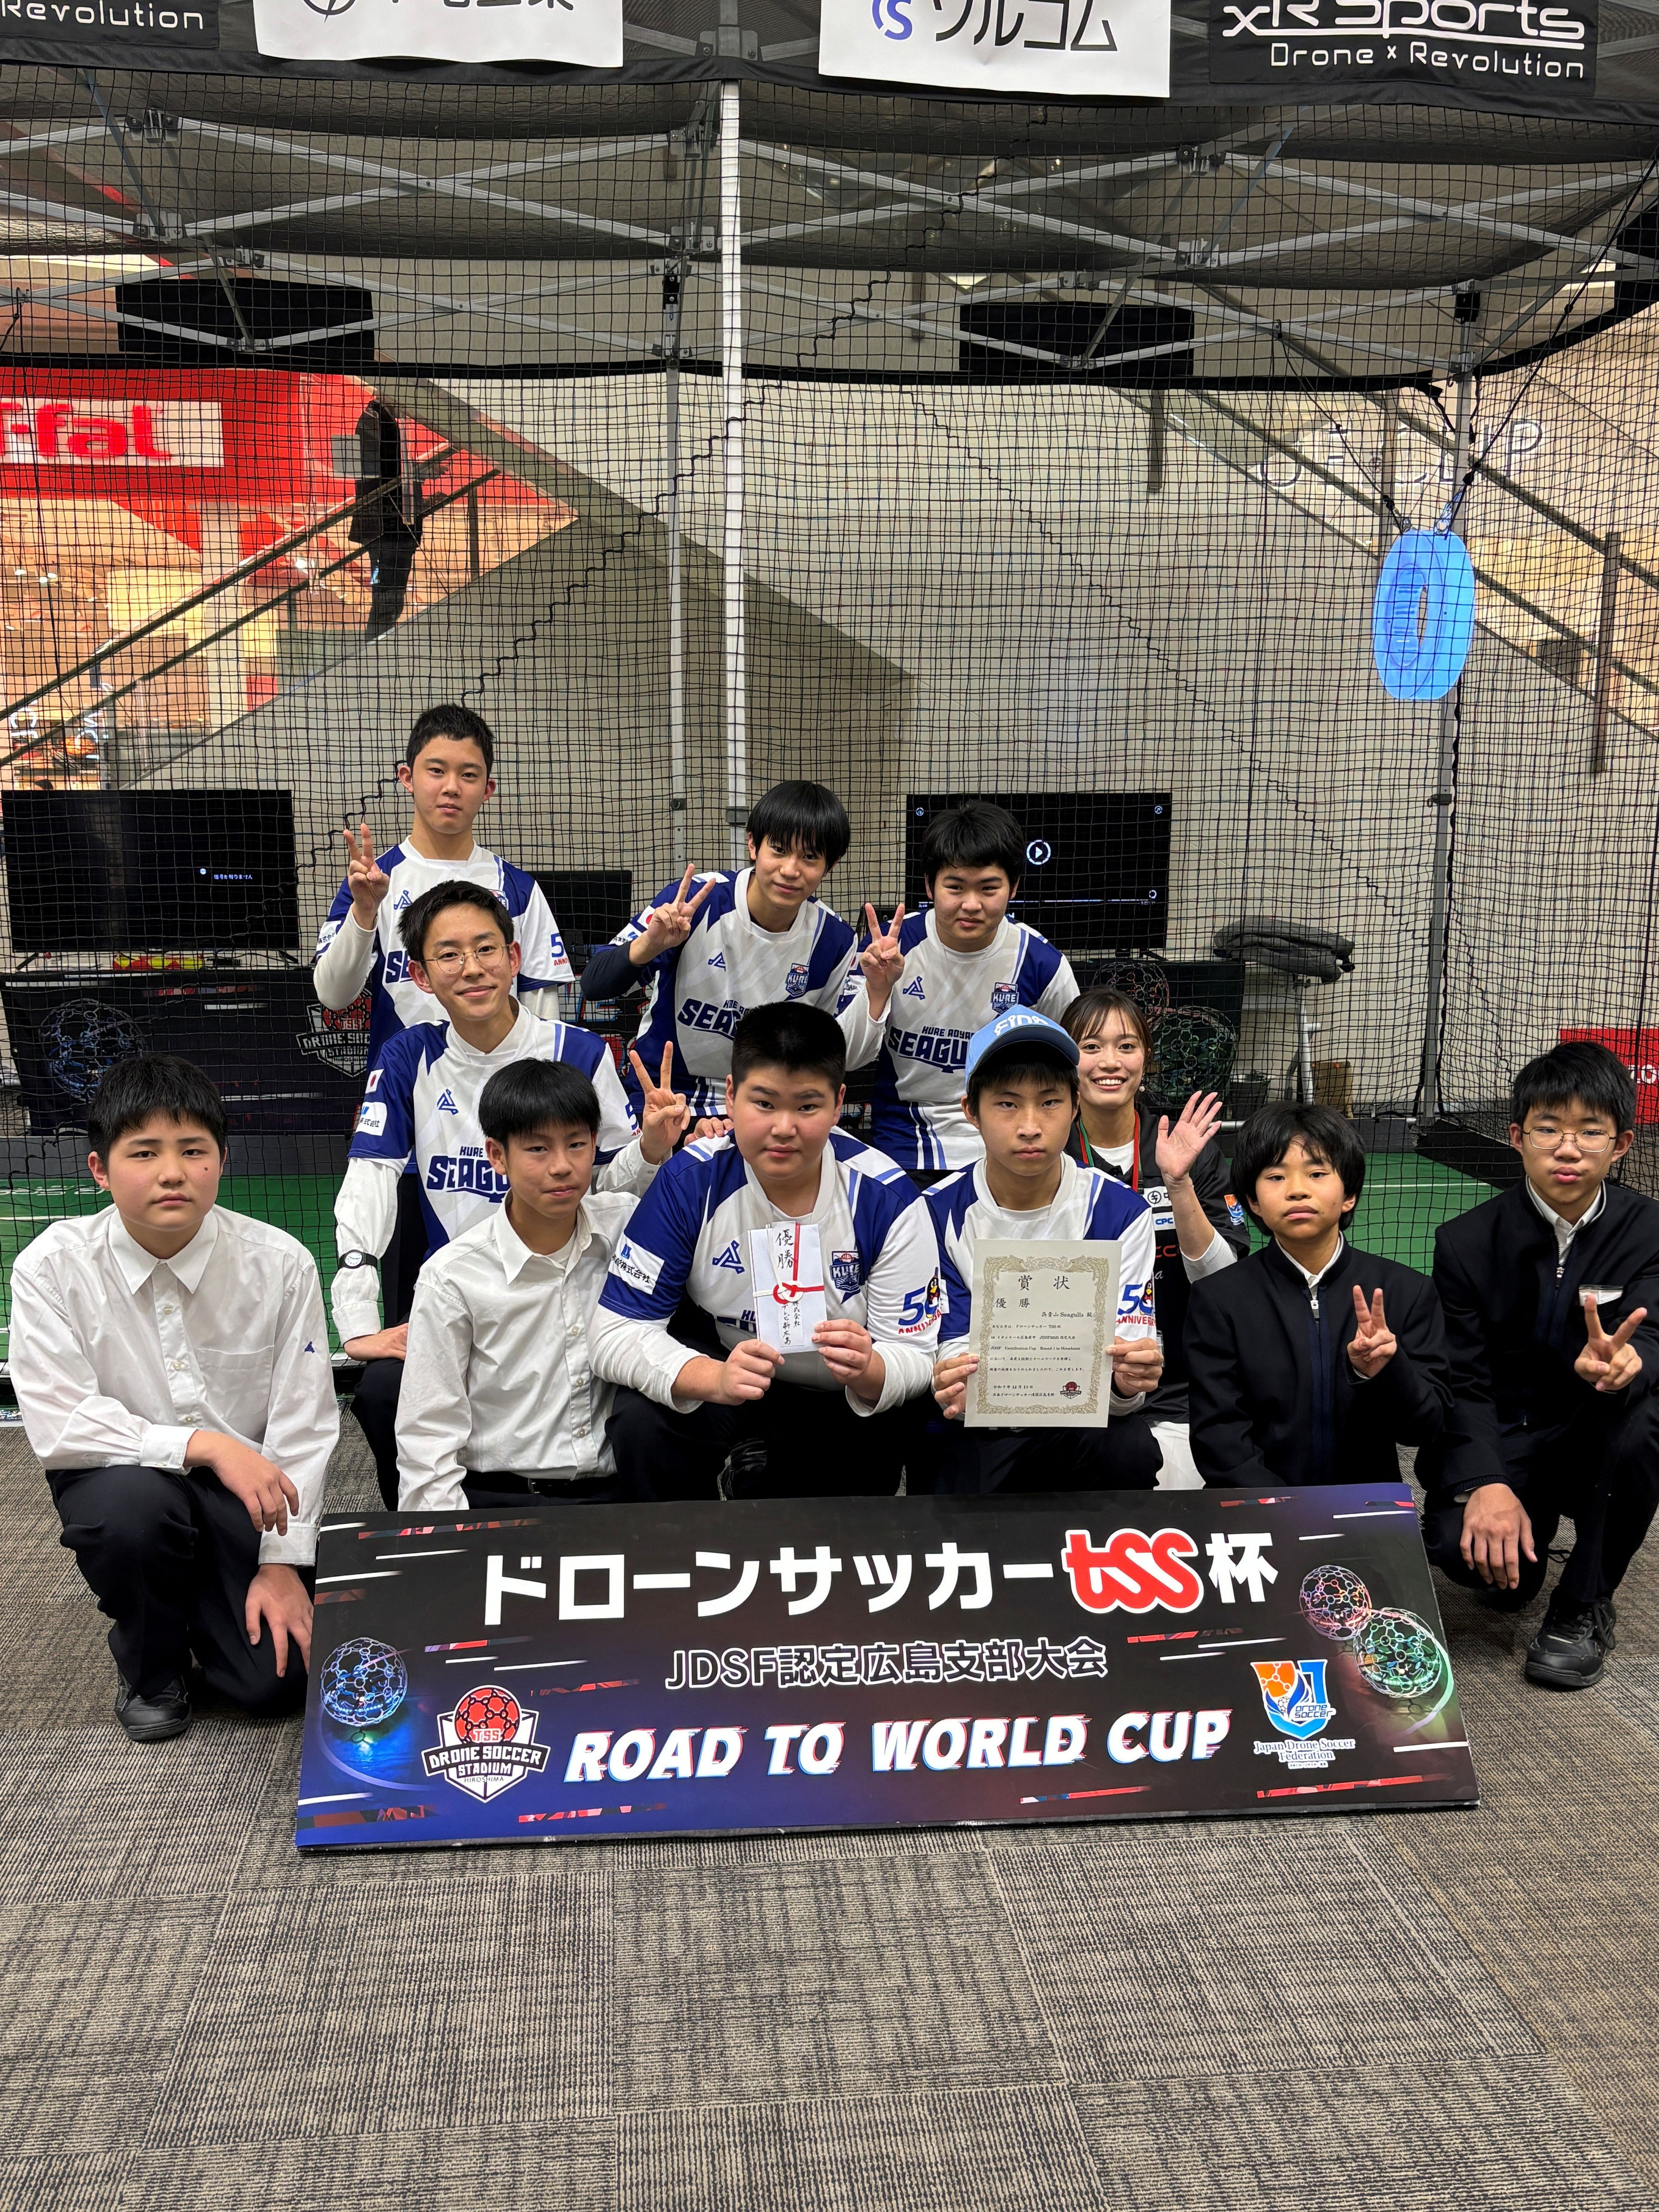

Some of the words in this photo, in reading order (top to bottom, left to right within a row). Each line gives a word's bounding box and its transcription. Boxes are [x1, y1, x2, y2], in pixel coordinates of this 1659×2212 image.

[1, 0, 203, 29] Revolution
[1271, 42, 1374, 66] Drone
[1410, 41, 1583, 79] Revolution
[992, 993, 1016, 1003] KURE
[921, 1026, 945, 1037] KURE
[460, 1145, 483, 1157] KURE
[775, 1229, 794, 1269] 優勝
[665, 1636, 1107, 1690] JDSF認定広島支部大会
[474, 1730, 500, 1741] TSS
[563, 1728, 749, 1783] ROAD
[764, 1721, 847, 1776] TO
[871, 1715, 1091, 1771] WORLD
[1106, 1708, 1233, 1764] CUP
[1256, 1741, 1285, 1752] Japan
[1286, 1739, 1318, 1749] Drone
[1320, 1737, 1354, 1748] Soccer
[428, 1746, 480, 1769] DRONE
[482, 1745, 542, 1765] SOCCER
[1280, 1750, 1333, 1761] Federation
[457, 1762, 512, 1776] STADIUM
